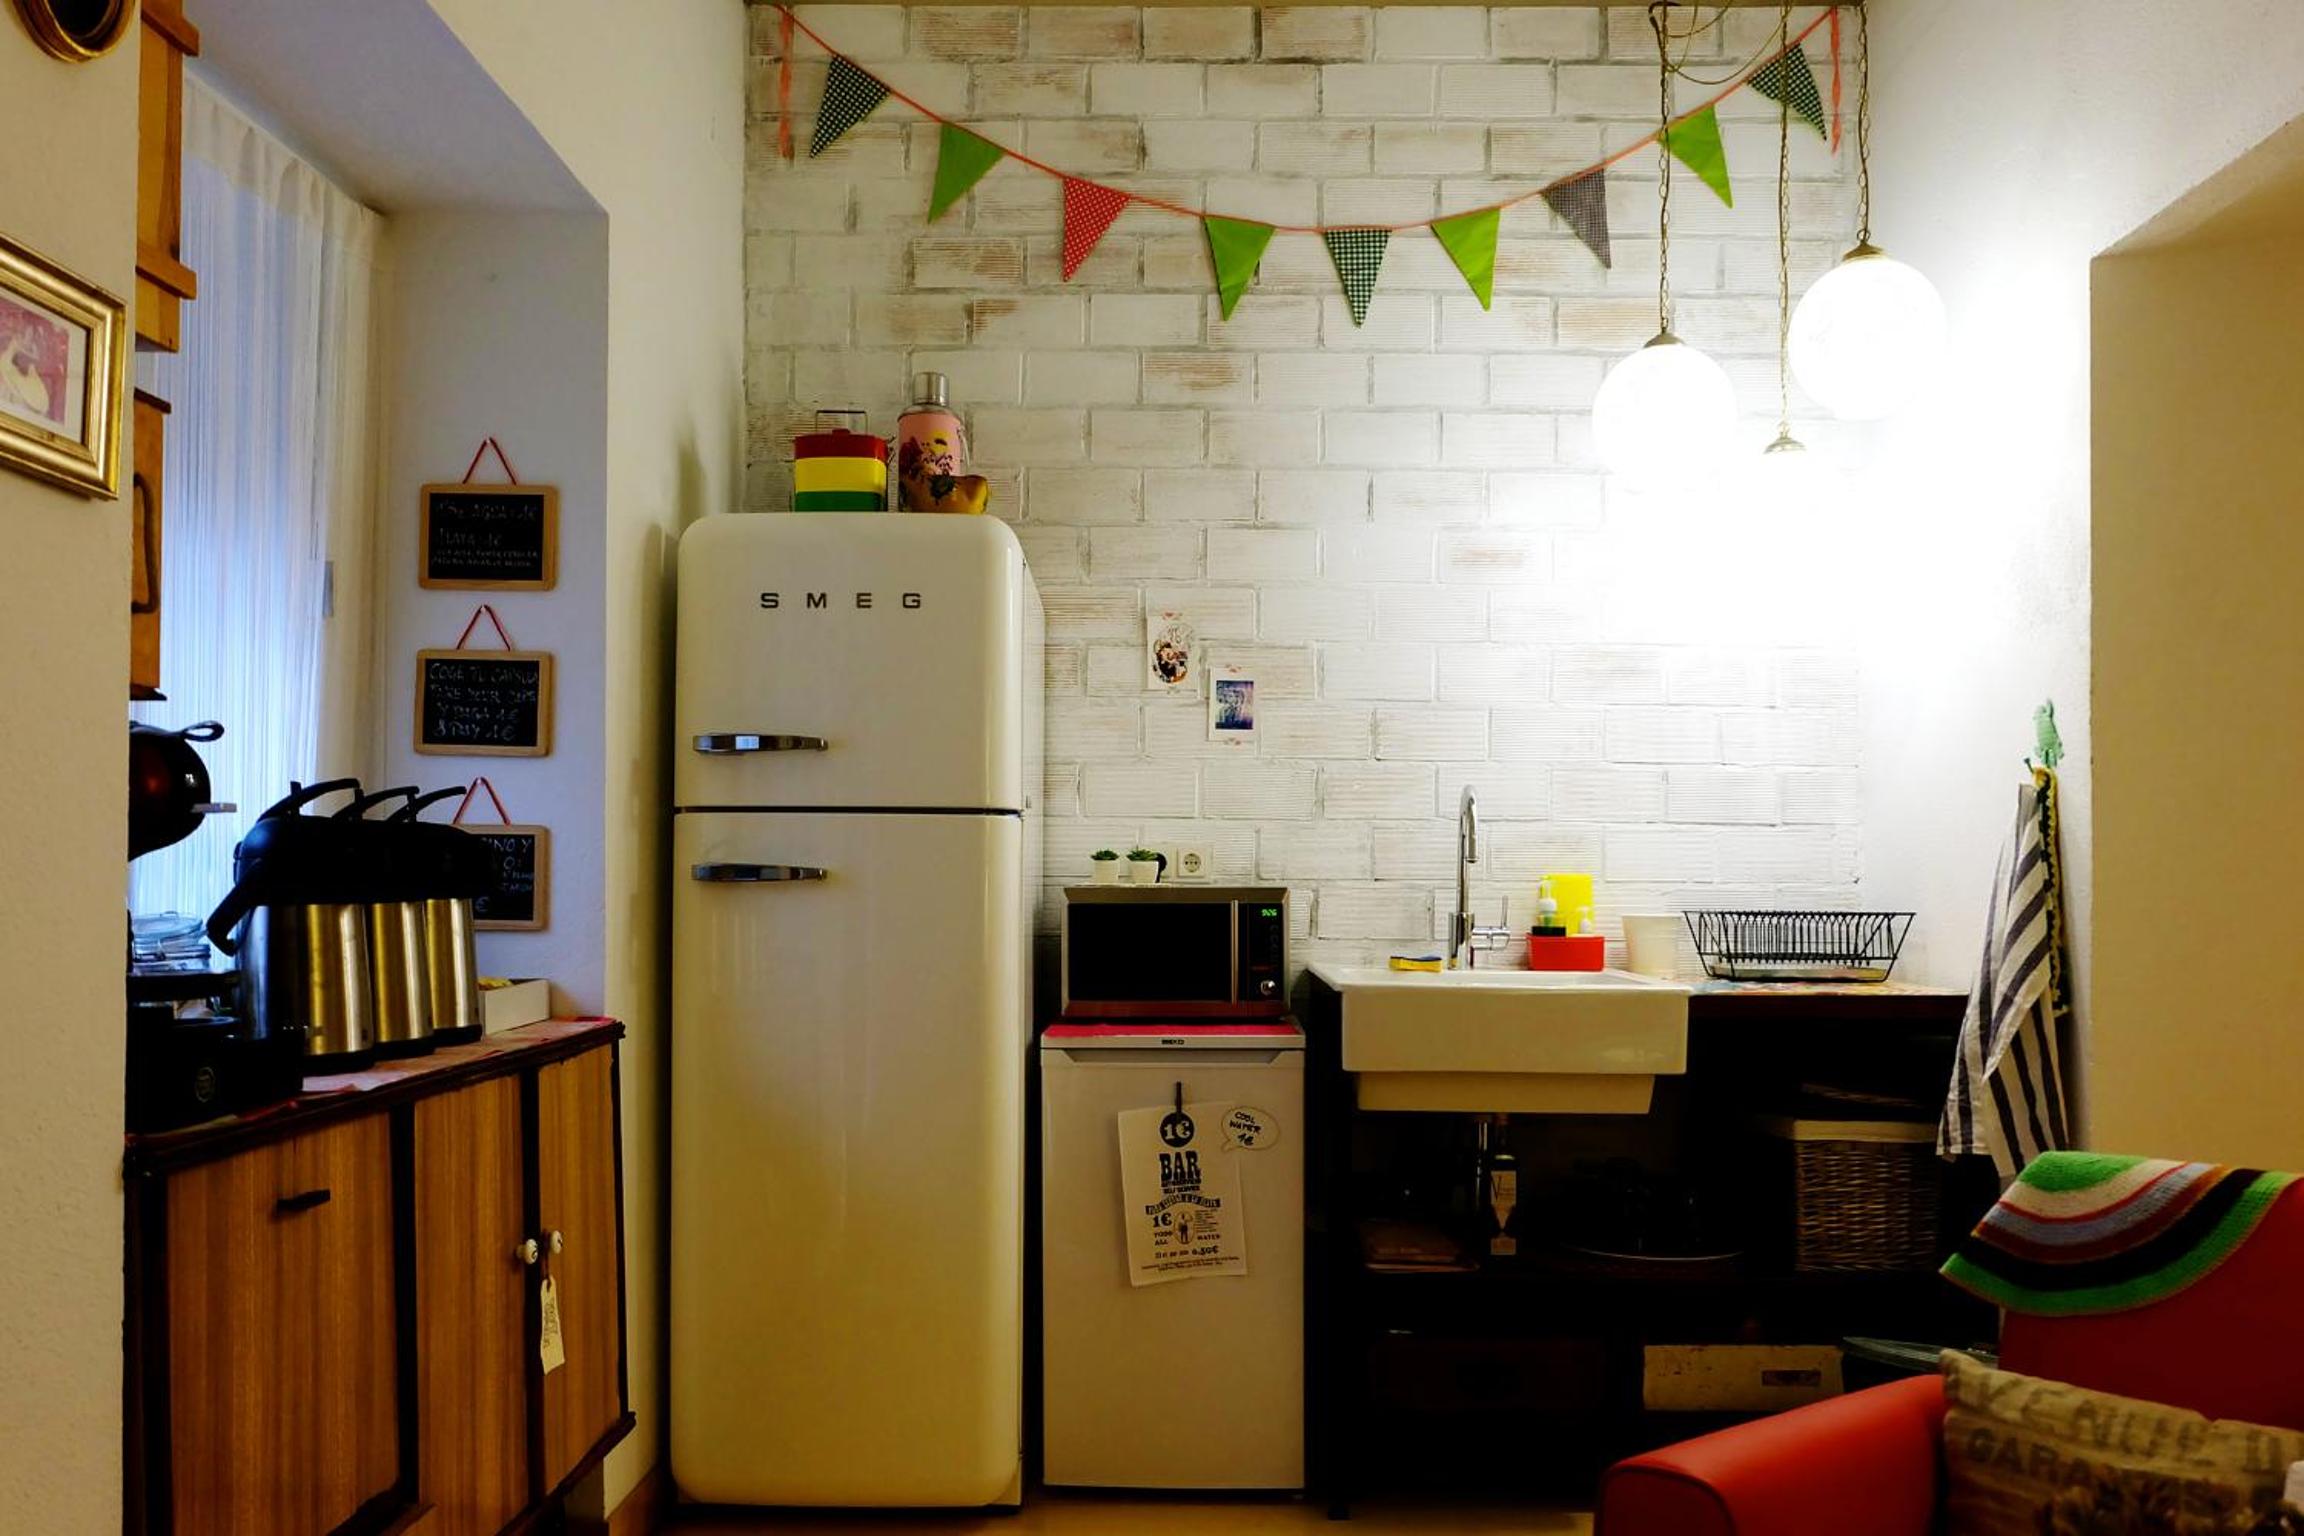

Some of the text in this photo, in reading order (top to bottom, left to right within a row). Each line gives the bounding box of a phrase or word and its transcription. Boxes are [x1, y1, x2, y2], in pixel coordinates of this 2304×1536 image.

[760, 593, 922, 608] SMEG
[430, 663, 464, 682] COGE
[1163, 1120, 1191, 1140] 1€
[1229, 1120, 1262, 1134] WATER
[1159, 1150, 1201, 1181] BAR
[1153, 1212, 1173, 1228] 1€
